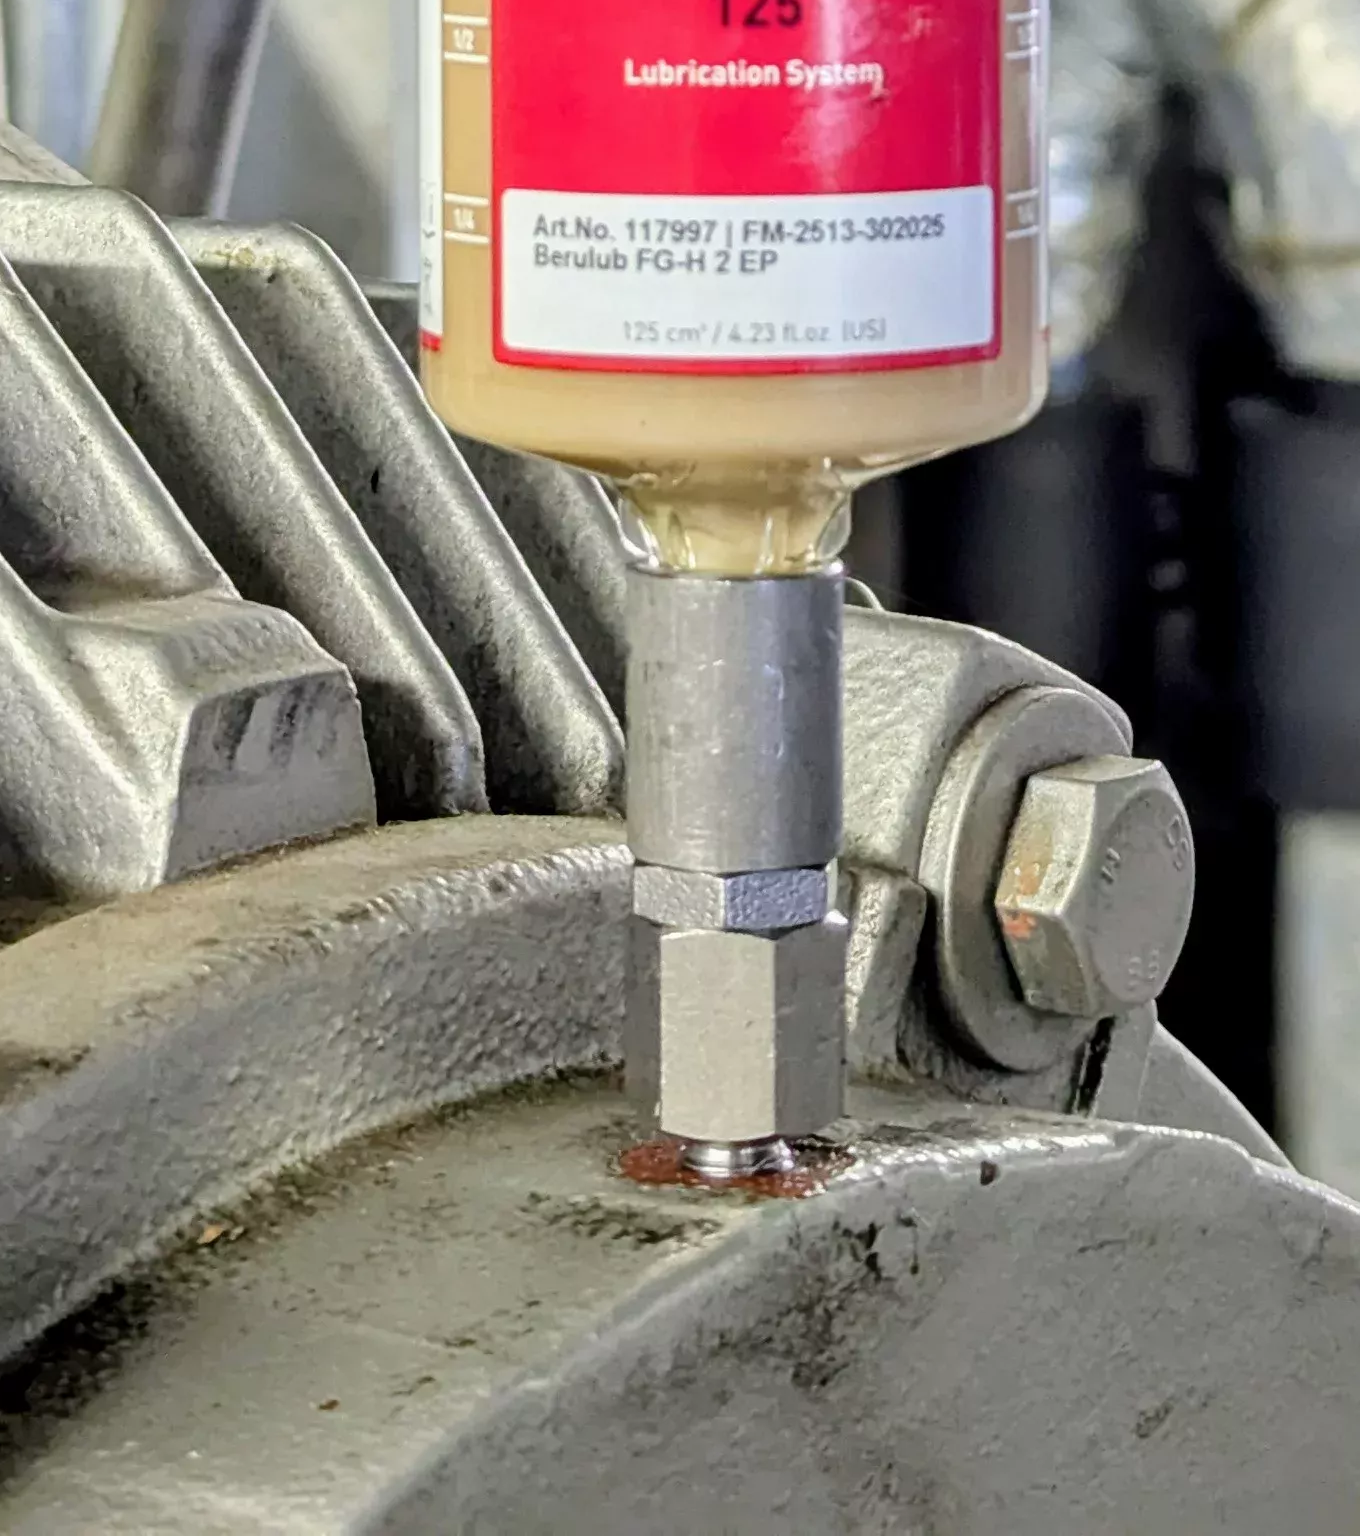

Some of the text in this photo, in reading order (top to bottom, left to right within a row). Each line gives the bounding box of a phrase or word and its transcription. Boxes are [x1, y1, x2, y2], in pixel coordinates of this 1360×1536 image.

[624, 59, 883, 93] Lubrication System
[625, 217, 717, 243] 117997
[742, 214, 945, 244] FM-2513-302025
[534, 243, 778, 273] Berulub FG-H 2 EP
[623, 320, 660, 342] 125
